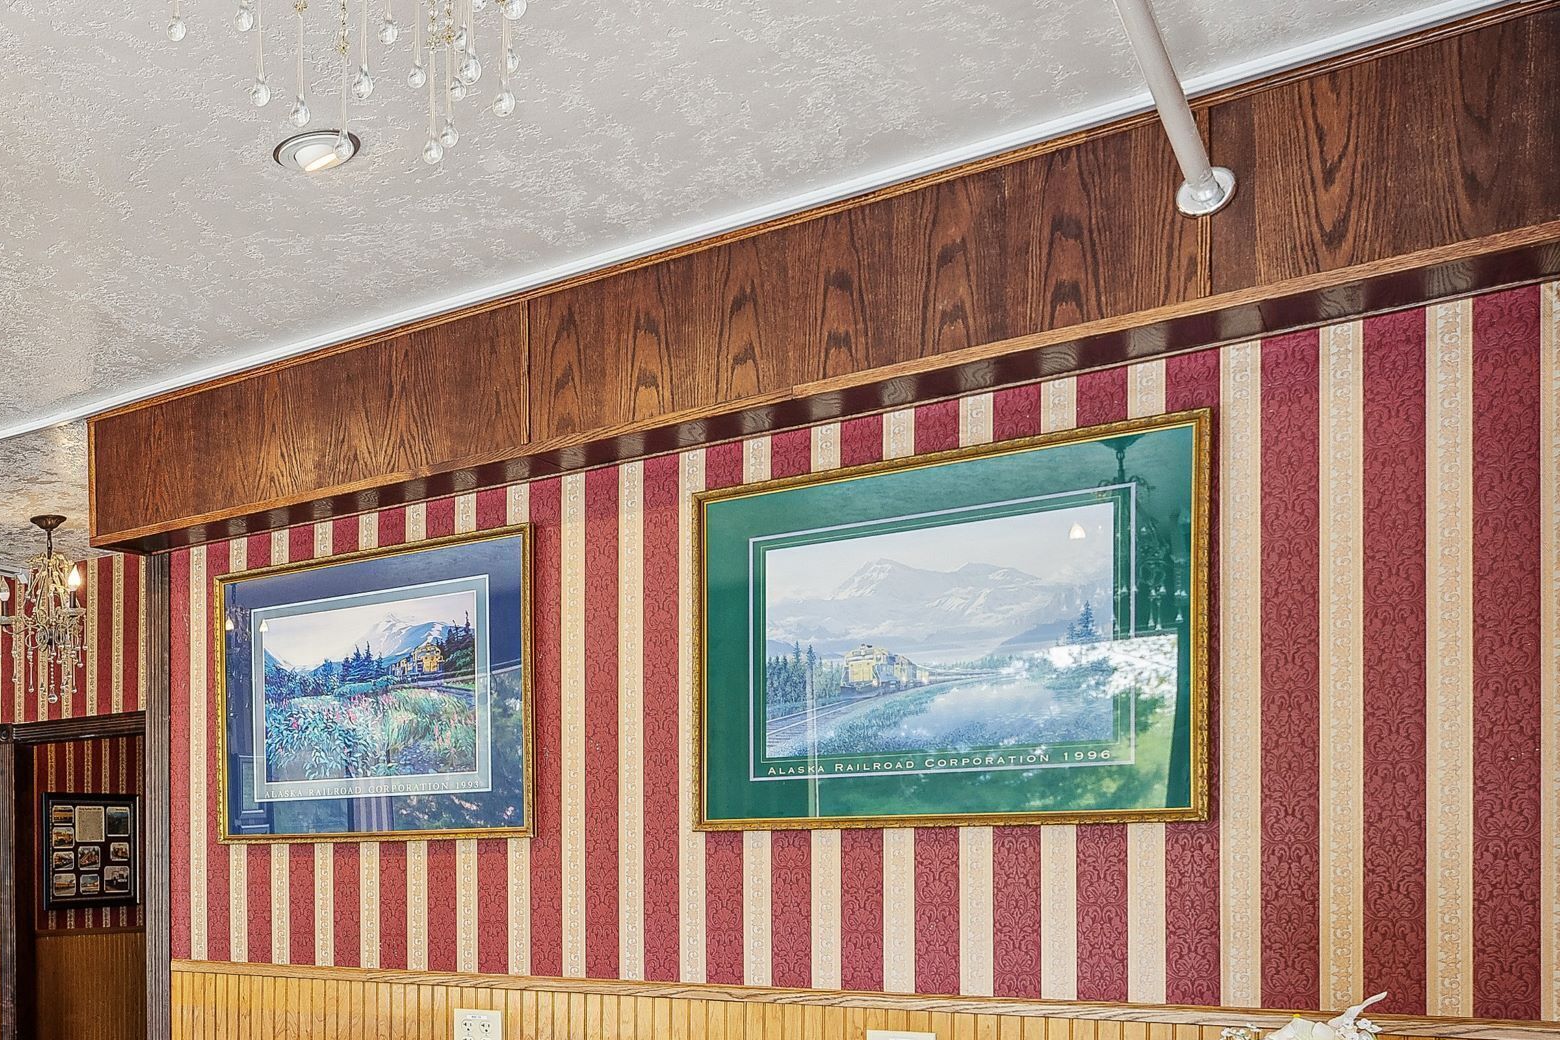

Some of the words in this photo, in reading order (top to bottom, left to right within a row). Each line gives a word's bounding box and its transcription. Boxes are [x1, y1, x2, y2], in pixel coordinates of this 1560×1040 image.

[768, 766, 825, 775] ALASKA
[834, 760, 914, 772] RAILROAD
[924, 754, 1050, 768] CORPORATION
[1064, 750, 1112, 760] 1996
[265, 789, 302, 798] ALASKA
[308, 787, 362, 796] RAILROAD
[368, 782, 448, 793] CORPORATION
[455, 781, 479, 790] 1993
